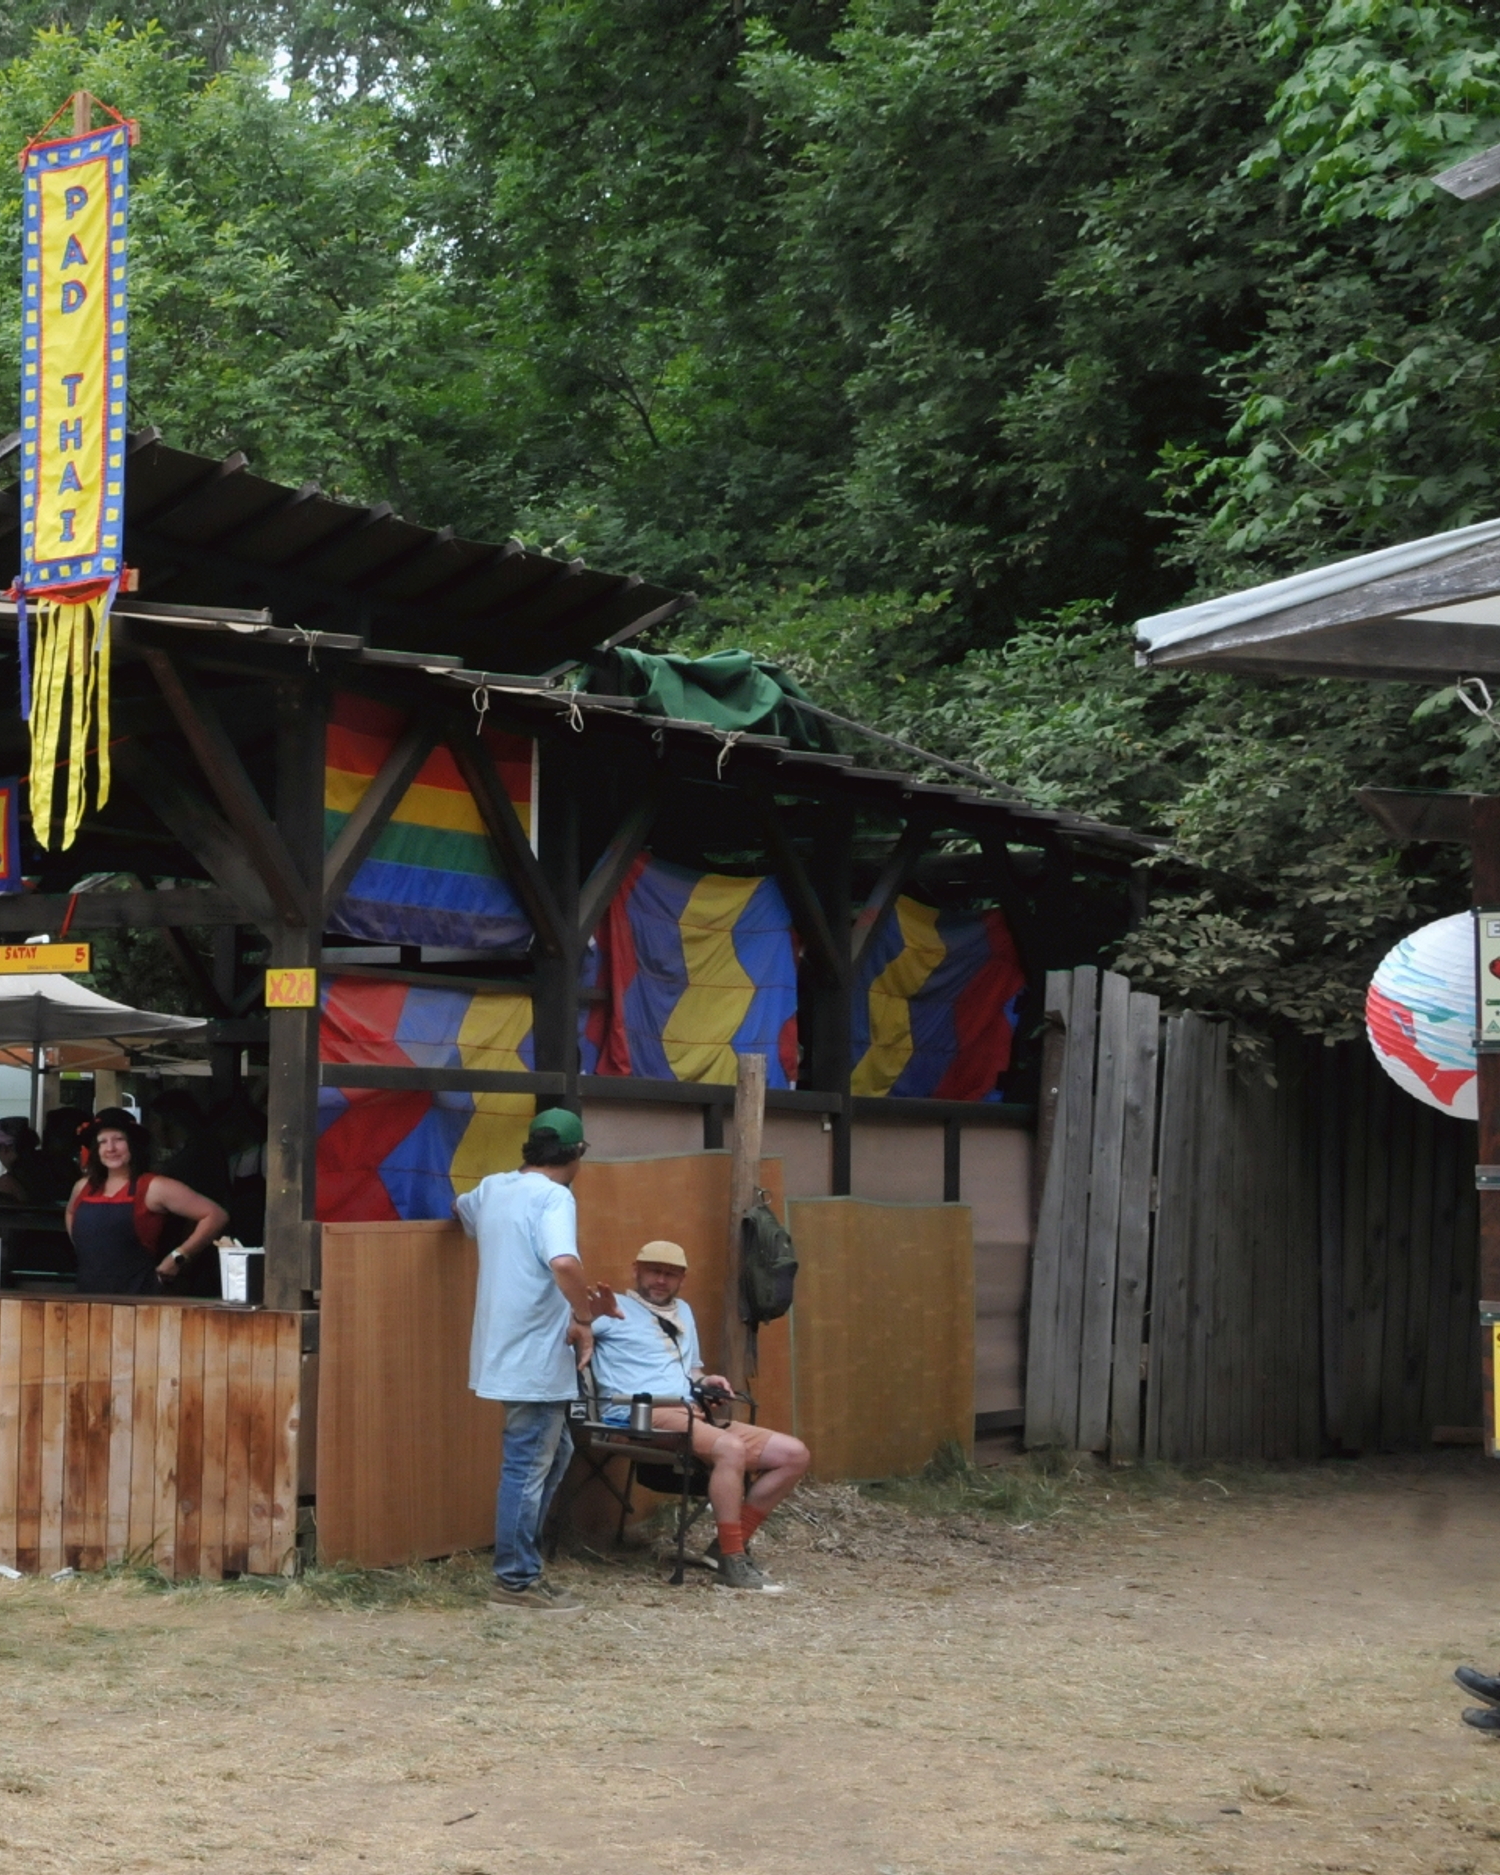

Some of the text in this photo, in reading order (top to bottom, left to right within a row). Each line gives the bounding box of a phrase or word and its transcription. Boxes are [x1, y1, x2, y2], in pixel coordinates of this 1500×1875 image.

[58, 185, 89, 542] PAD THAI
[5, 947, 37, 960] SATAY
[75, 947, 86, 963] 5
[269, 972, 313, 1003] X28
